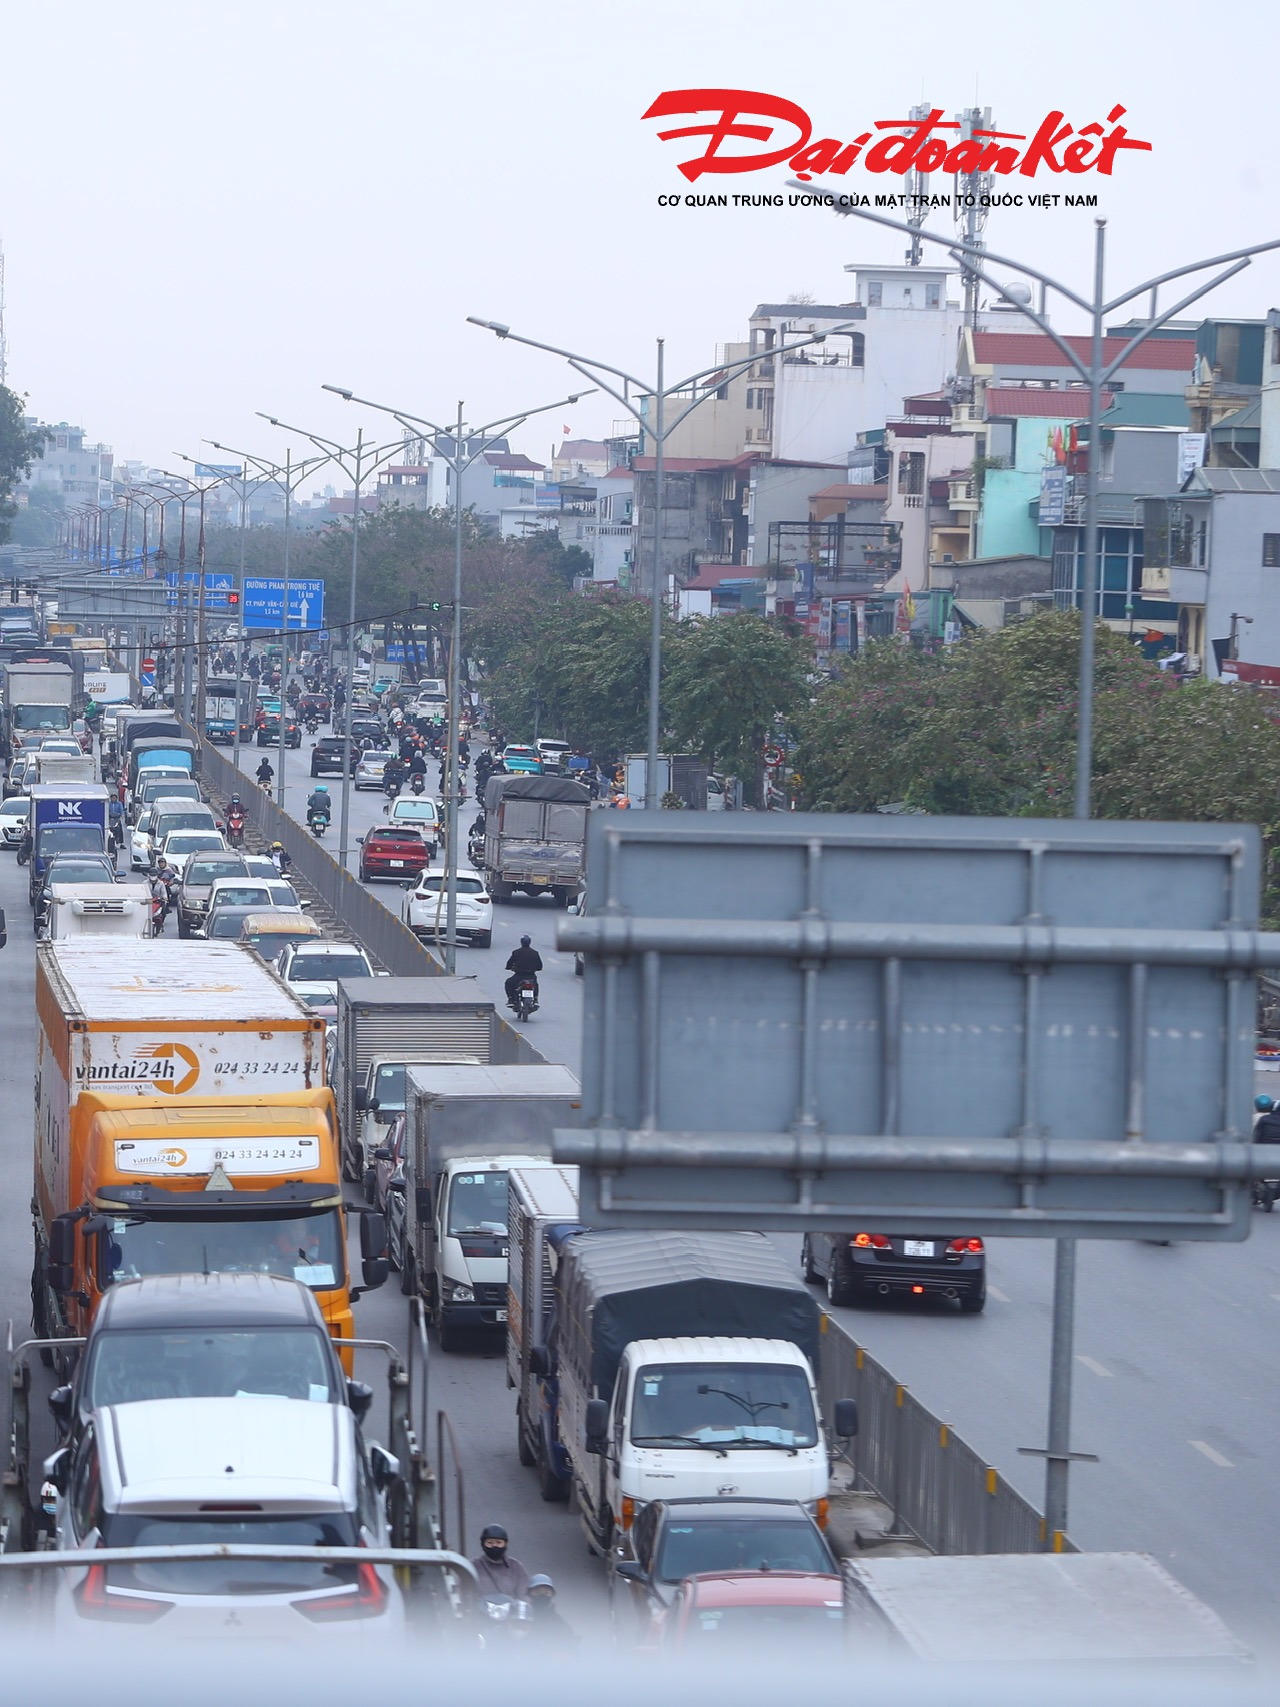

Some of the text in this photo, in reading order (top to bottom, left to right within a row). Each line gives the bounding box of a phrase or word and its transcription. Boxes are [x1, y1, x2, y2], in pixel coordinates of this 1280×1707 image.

[58, 801, 82, 816] NK
[75, 1059, 175, 1079] vantai24h
[214, 1061, 238, 1075] 024
[241, 1061, 259, 1075] 33
[261, 1061, 280, 1075] 24
[282, 1061, 299, 1075] 24
[133, 1153, 177, 1165] vantai24h
[215, 1149, 302, 1160] 024 33 24 24 24
